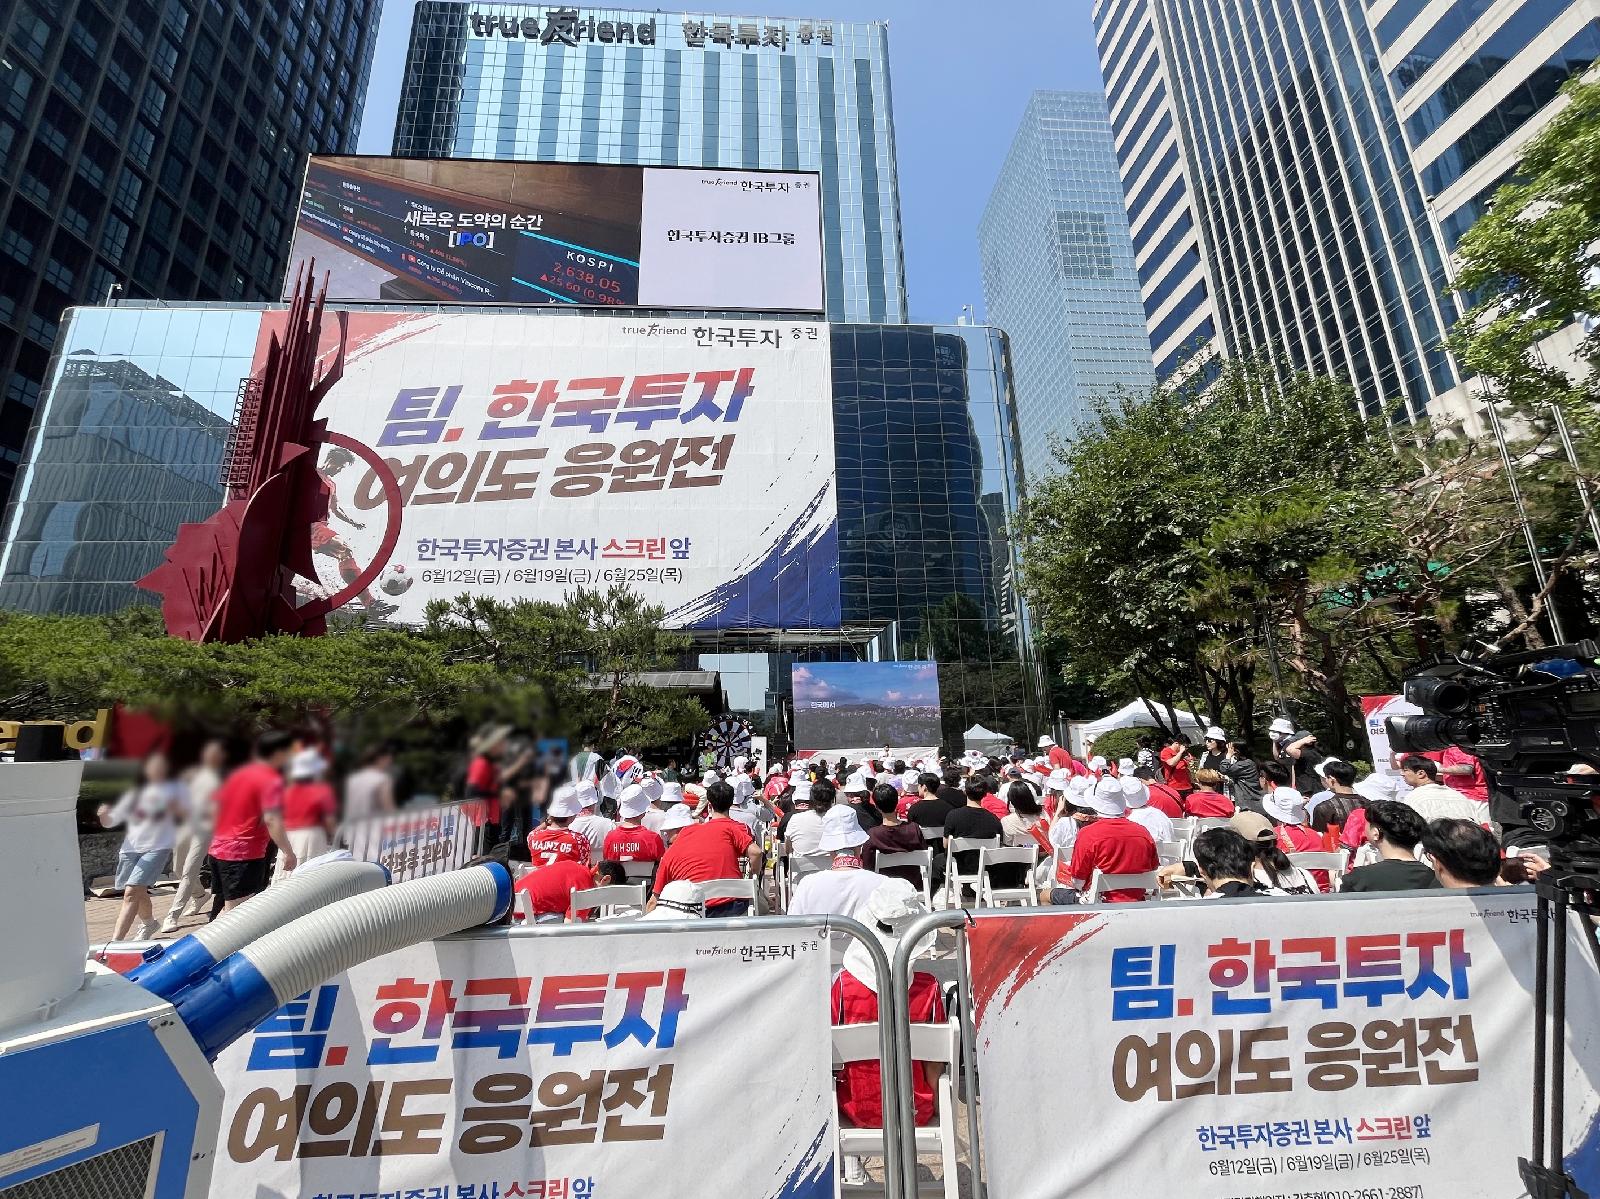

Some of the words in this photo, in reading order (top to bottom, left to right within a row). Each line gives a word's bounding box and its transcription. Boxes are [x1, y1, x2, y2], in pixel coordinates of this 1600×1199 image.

[682, 20, 789, 52] 한국투자
[740, 180, 790, 193] 한국투자
[404, 211, 454, 227] 새로운
[457, 212, 507, 229] 도약의
[510, 213, 543, 230] 순간
[753, 232, 795, 245] IB그룹
[566, 250, 613, 272] KOSPI
[692, 326, 782, 348] 한국투자
[791, 327, 818, 340] 증권
[376, 385, 465, 447] 팀.
[477, 368, 755, 441] 한국투자
[353, 446, 549, 510] 여의도
[550, 433, 736, 498] 응원전
[417, 537, 549, 562] 한국투자증권
[553, 537, 598, 561] 본사
[602, 537, 666, 560] 스크린
[669, 537, 690, 560] 앞
[422, 568, 501, 585] 6월12일(금)
[513, 567, 592, 584] 6월19일(금)
[603, 567, 683, 584] 6월25일(목)
[532, 840, 559, 851] MAINZ
[560, 843, 572, 853] 05
[740, 944, 796, 962] 한국투자
[801, 940, 818, 951] 증권
[1110, 944, 1194, 1021] 팀.
[1207, 929, 1472, 1016] 한국투자
[367, 967, 689, 1067] 한국투자
[1112, 1026, 1294, 1103] 여의도
[1304, 1014, 1479, 1092] 응원전
[227, 1079, 454, 1164] 여의도
[458, 1064, 674, 1155] 응원전
[1196, 1119, 1312, 1152] 한국투자증권
[1313, 1117, 1353, 1144] 본사
[1356, 1115, 1413, 1141] 스크린
[1413, 1113, 1432, 1139] 앞
[1209, 1157, 1277, 1177] 6월12일(금)
[1287, 1153, 1353, 1172] 6월19일(금)
[1364, 1147, 1431, 1166] 6월25일(목)
